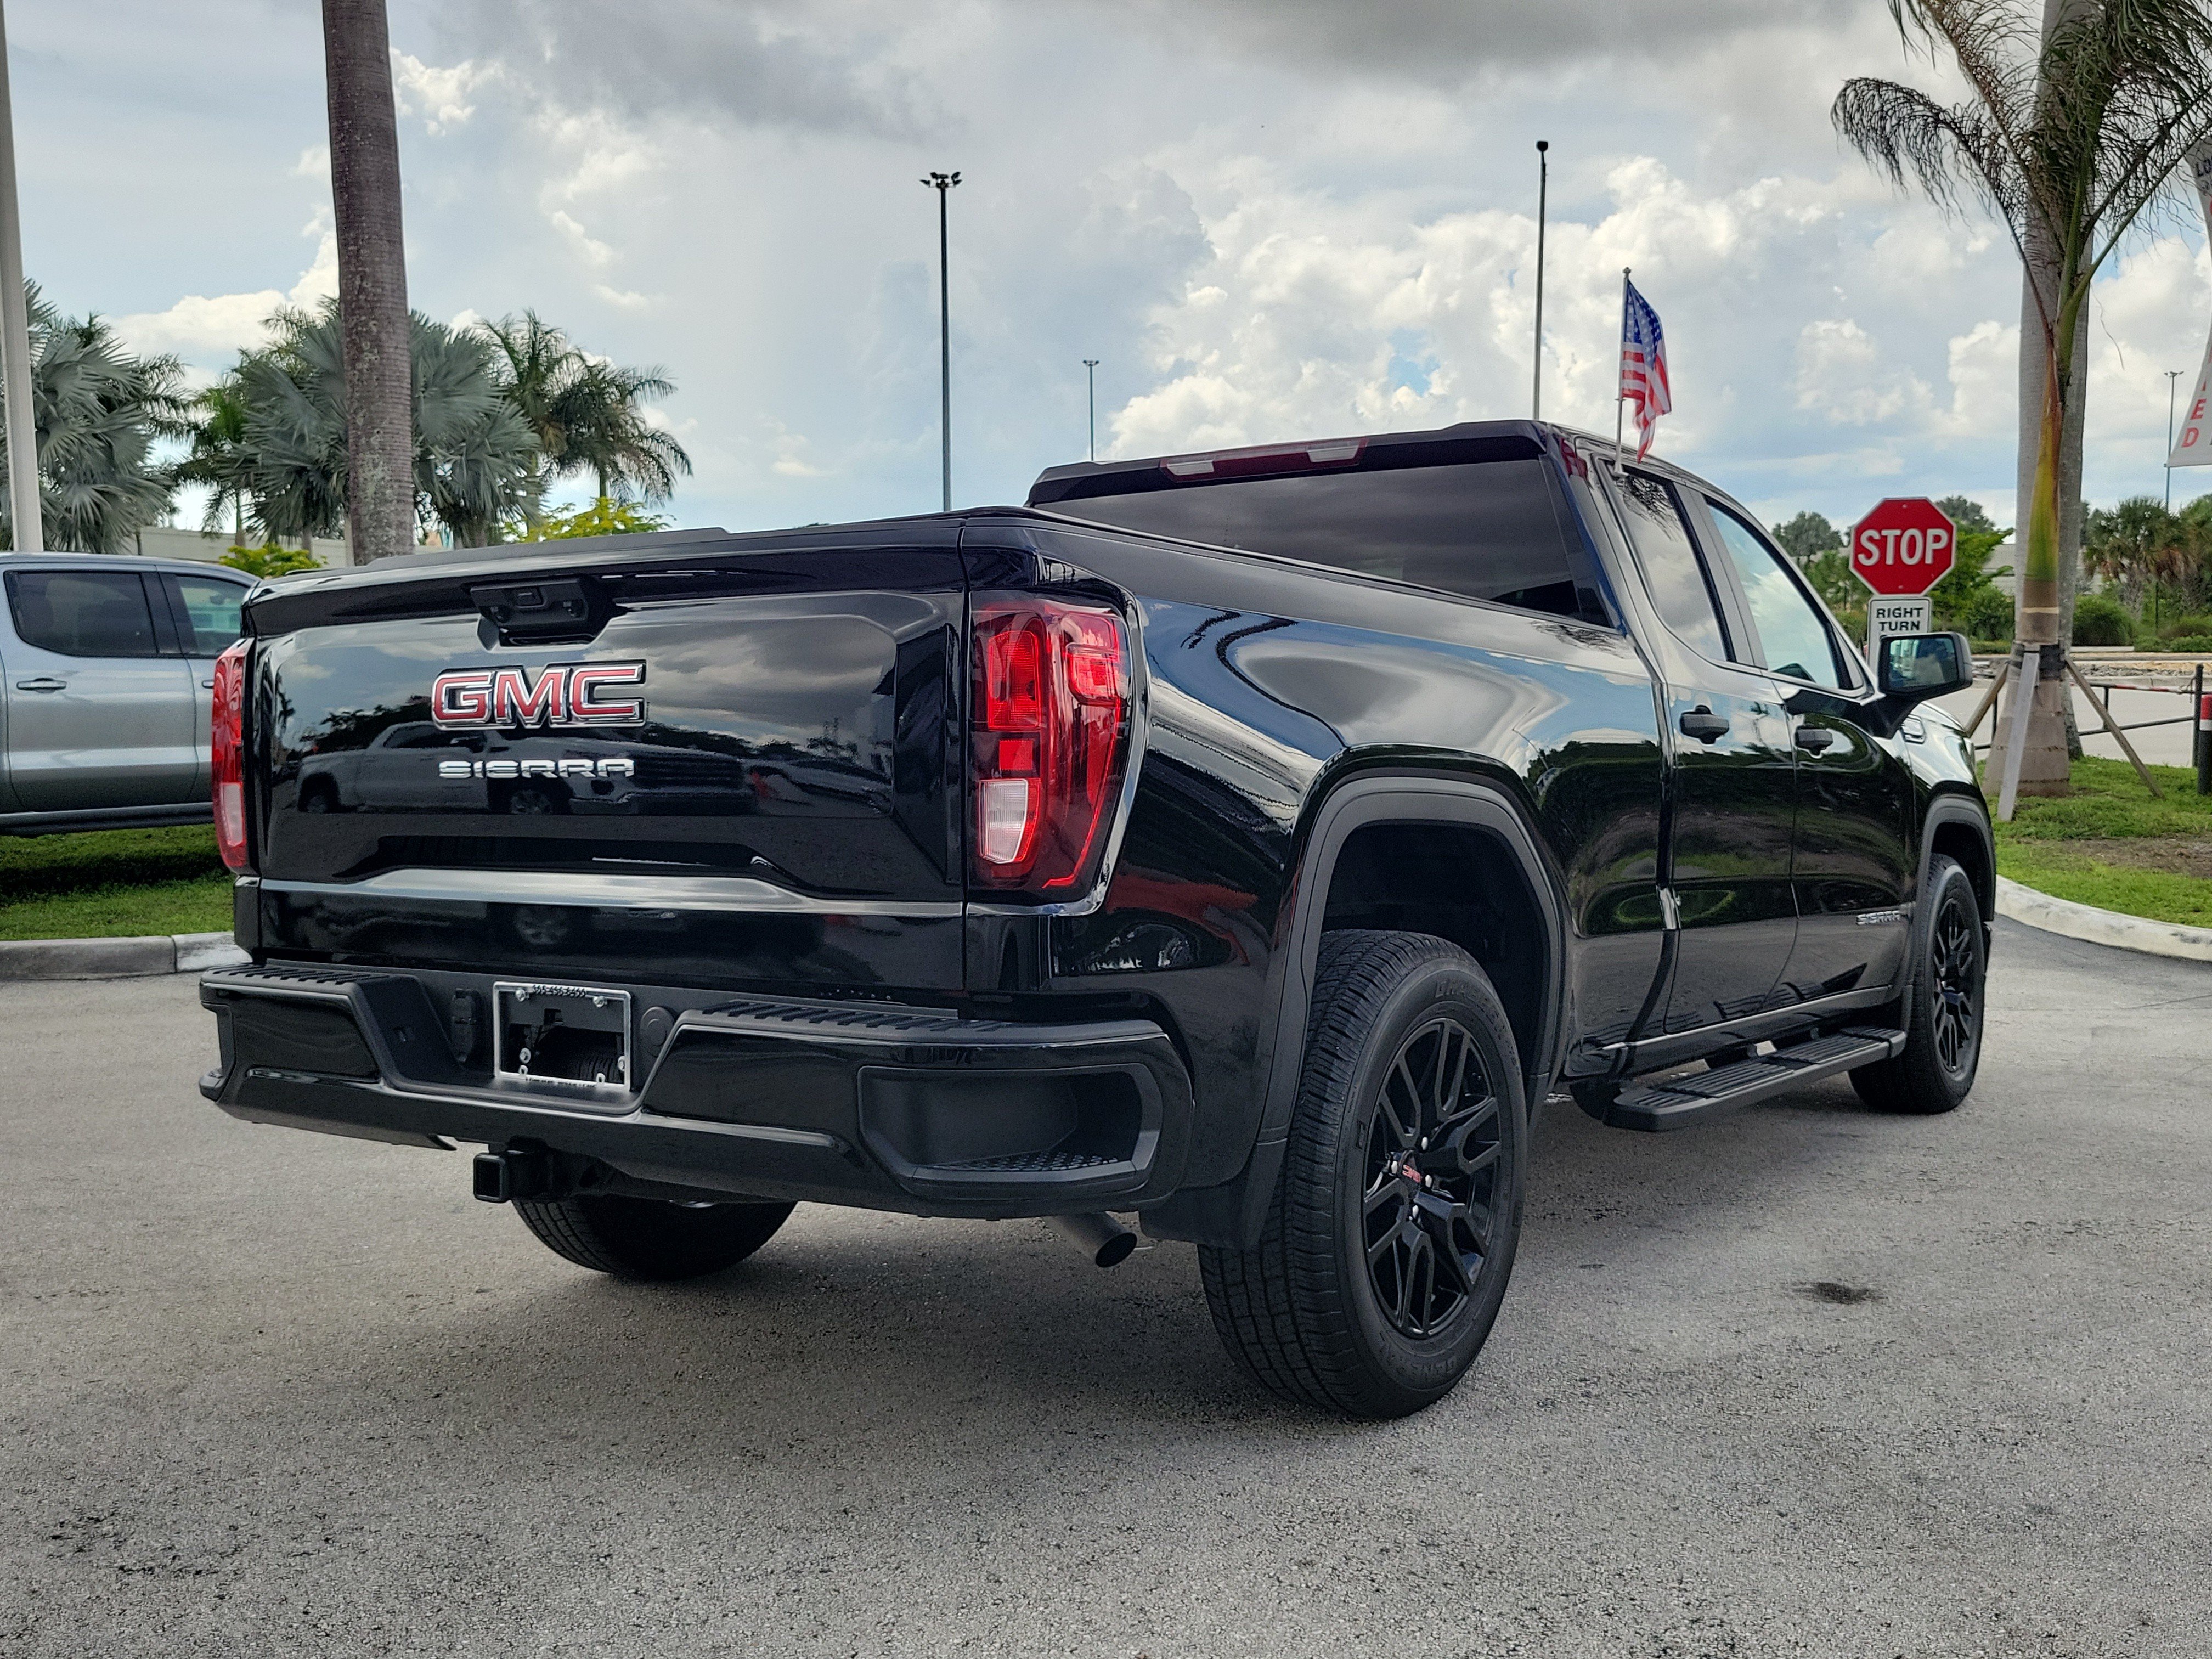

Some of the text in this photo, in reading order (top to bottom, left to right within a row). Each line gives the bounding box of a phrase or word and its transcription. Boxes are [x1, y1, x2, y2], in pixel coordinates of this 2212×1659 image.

[1857, 528, 1949, 566] STOP
[1876, 607, 1923, 618] RIGHT
[1878, 620, 1920, 631] TURN
[432, 661, 646, 730] GMC
[439, 758, 635, 778] SIERRA
[1856, 910, 1900, 925] SIERRA
